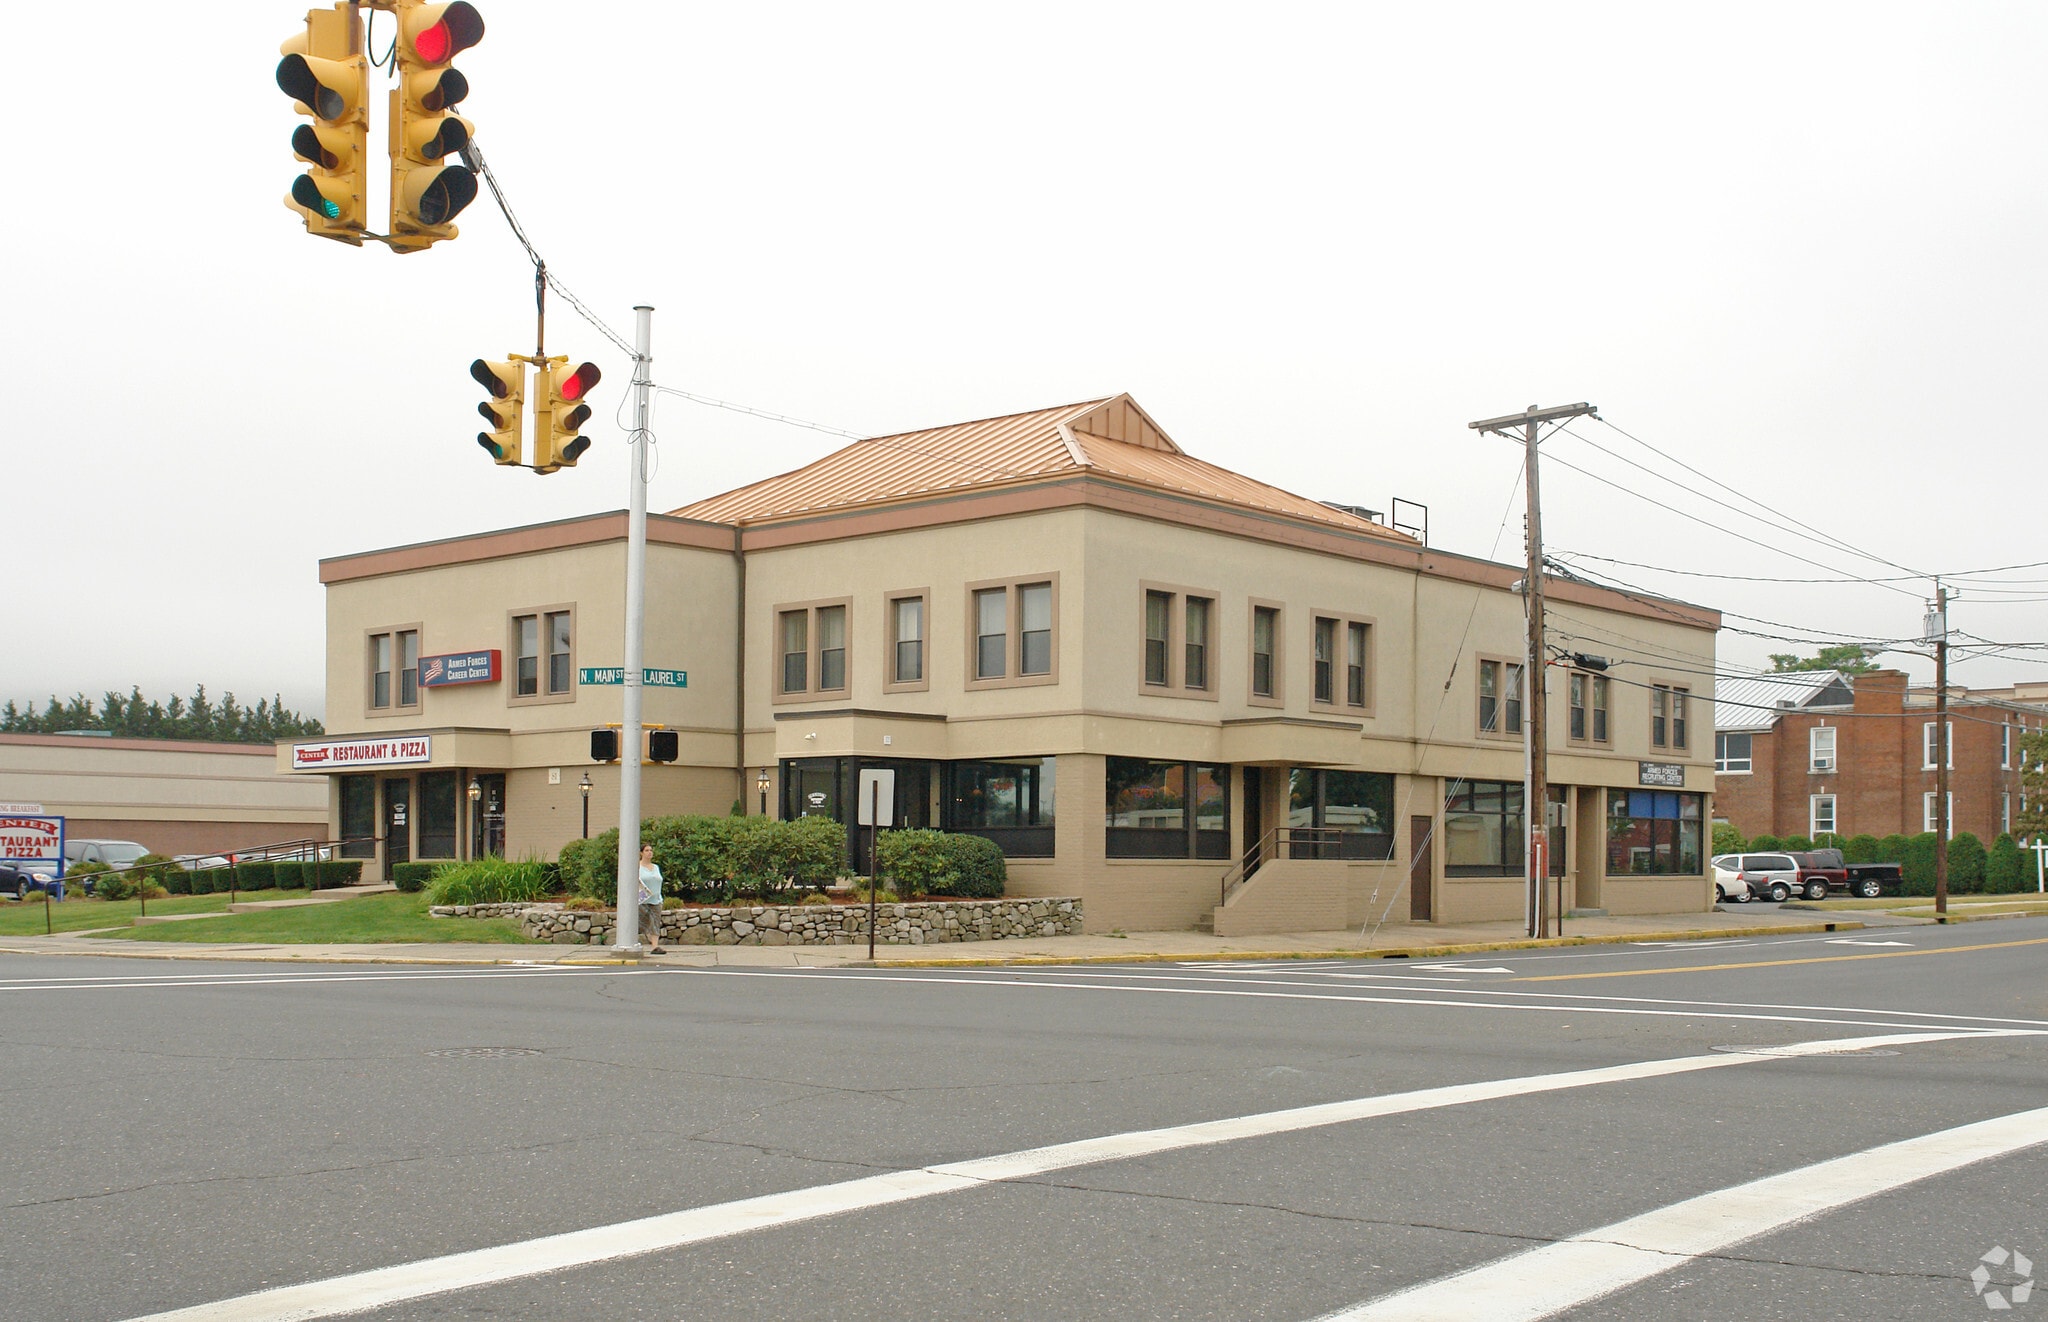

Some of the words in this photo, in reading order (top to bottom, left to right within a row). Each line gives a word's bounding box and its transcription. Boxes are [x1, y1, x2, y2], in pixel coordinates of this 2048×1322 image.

[448, 659, 466, 668] ARMED
[467, 657, 487, 666] FORCES
[448, 671, 467, 680] CAREER
[468, 668, 488, 678] CENTER
[580, 670, 590, 683] N.
[594, 670, 615, 683] MAIN
[616, 669, 624, 679] ST
[643, 670, 676, 685] LAUREL
[677, 673, 685, 681] ST
[300, 751, 325, 759] CENTER
[333, 744, 388, 761] RESTAURANT
[391, 743, 397, 757] &
[400, 741, 427, 757] PIZZA
[6, 847, 42, 857] PIZZA
